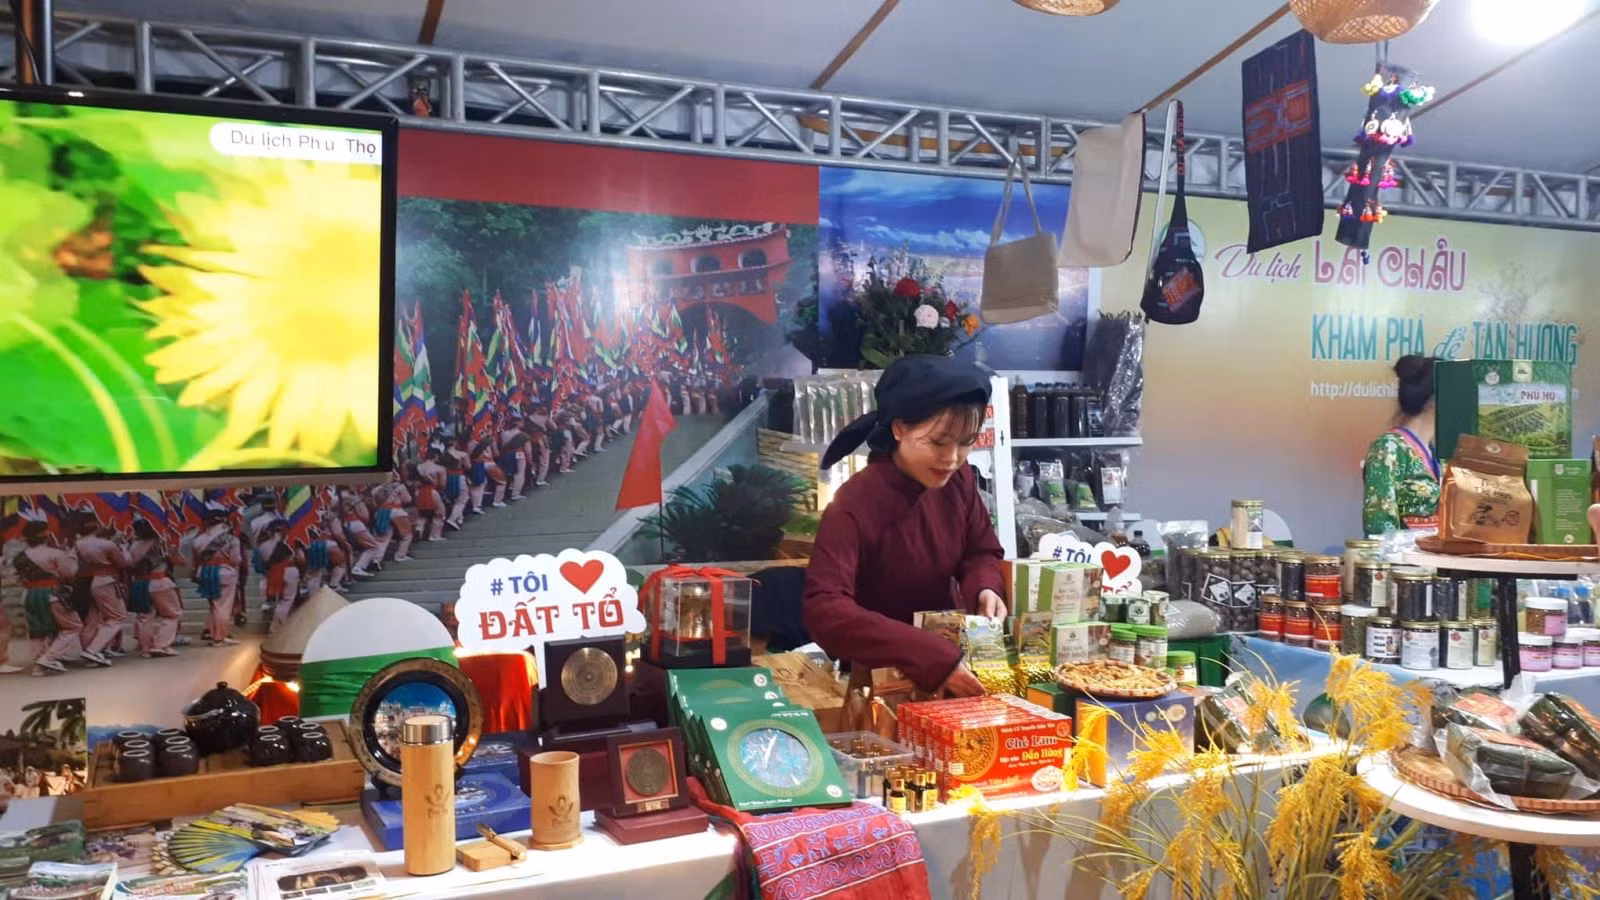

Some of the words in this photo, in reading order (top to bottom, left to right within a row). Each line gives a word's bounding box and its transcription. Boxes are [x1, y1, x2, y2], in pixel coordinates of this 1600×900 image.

[231, 130, 254, 145] Du
[262, 131, 292, 150] lịch
[345, 138, 376, 157] Thọ
[1215, 244, 1261, 278] Du
[1266, 251, 1302, 282] lịch
[1311, 309, 1377, 360] KHÁM
[478, 596, 560, 640] ĐẤT
[572, 586, 624, 630] TỔ
